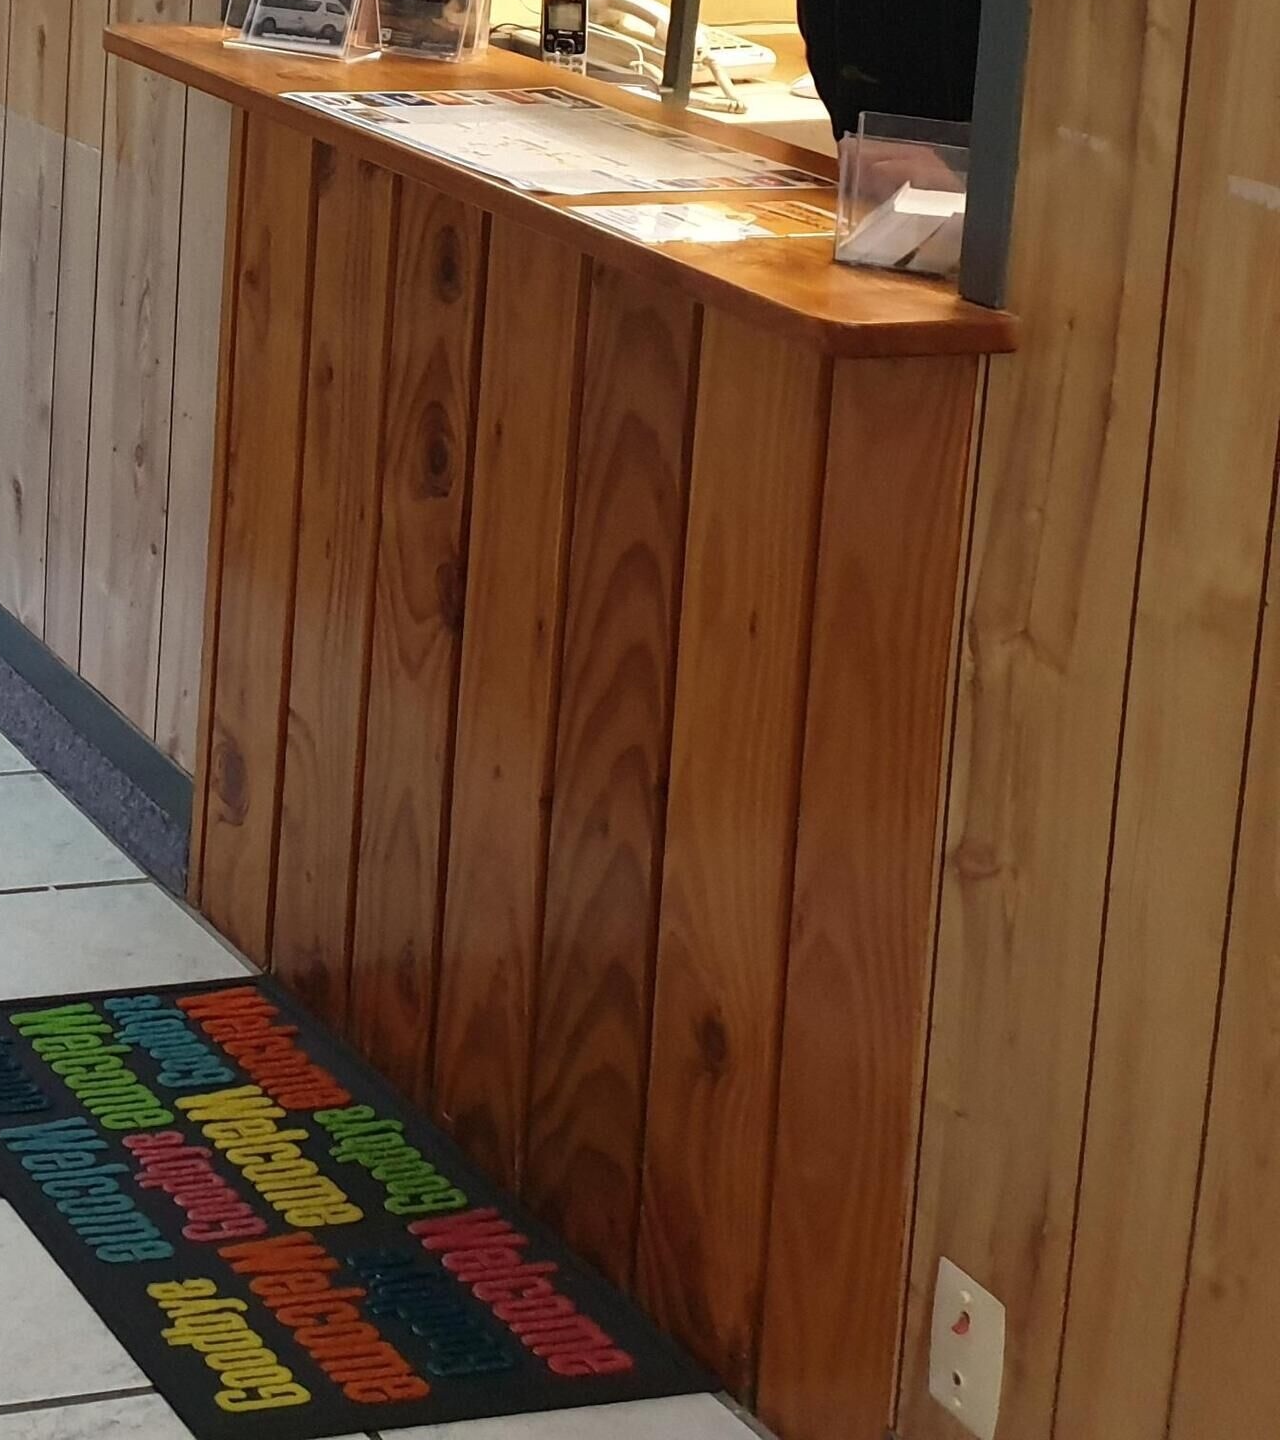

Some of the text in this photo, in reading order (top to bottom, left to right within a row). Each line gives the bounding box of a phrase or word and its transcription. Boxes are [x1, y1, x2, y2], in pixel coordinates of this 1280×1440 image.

[9, 1002, 175, 1131] Welcome
[103, 994, 236, 1088] Goodbye
[175, 986, 352, 1110] Welcome
[122, 1130, 268, 1242] Goodbye
[174, 1085, 365, 1228] Welcome
[313, 1106, 468, 1215] Goodbye
[146, 1277, 312, 1413] Goodbye
[217, 1231, 431, 1403] Welcome
[407, 1208, 634, 1377] Welcome
